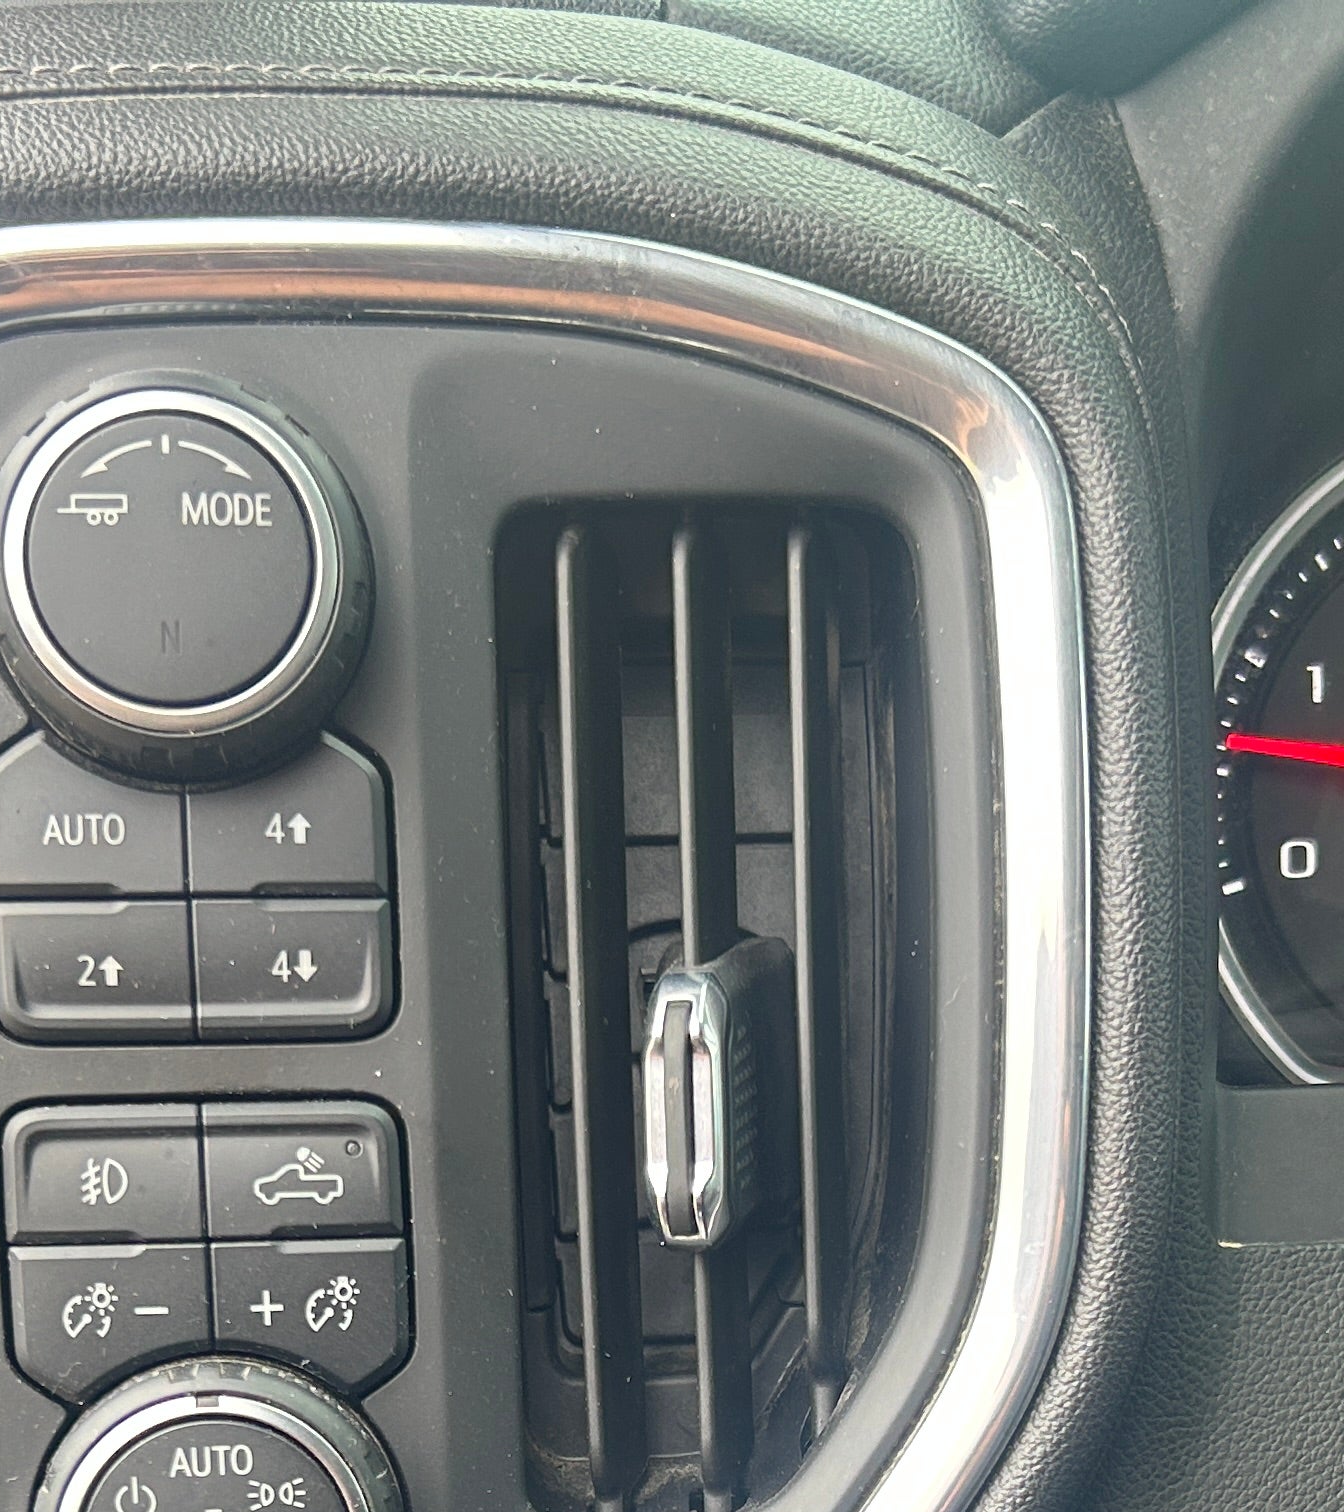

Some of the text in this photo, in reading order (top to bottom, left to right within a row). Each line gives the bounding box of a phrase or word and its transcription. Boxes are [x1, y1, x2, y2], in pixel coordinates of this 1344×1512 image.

[181, 491, 273, 527] MODE
[160, 620, 183, 655] N
[1304, 662, 1326, 705] 1
[42, 813, 127, 847] AUTO
[264, 813, 286, 845] 4
[1278, 840, 1318, 880] 0
[76, 954, 98, 988] 2
[270, 949, 292, 983] 4
[169, 1444, 254, 1479] AUTO
